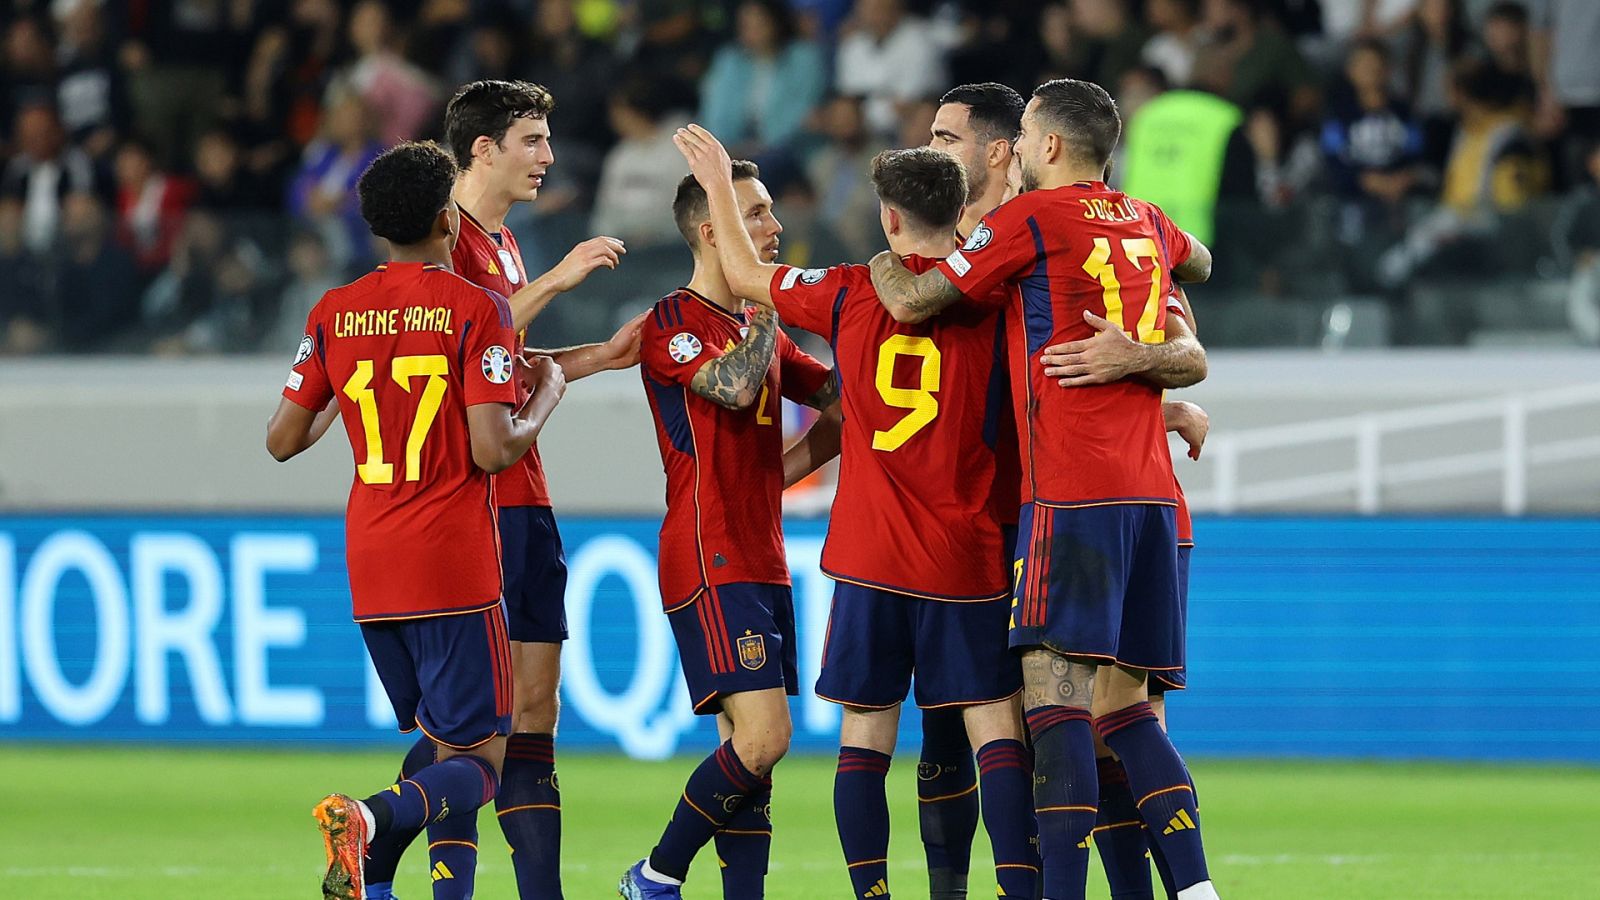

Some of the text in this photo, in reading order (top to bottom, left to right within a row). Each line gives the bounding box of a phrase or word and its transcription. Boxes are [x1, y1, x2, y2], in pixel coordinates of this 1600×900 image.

[335, 306, 453, 338] LAMINE YAMAL
[342, 354, 449, 485] 17
[872, 334, 941, 452] 9
[0, 528, 326, 728] ORE
